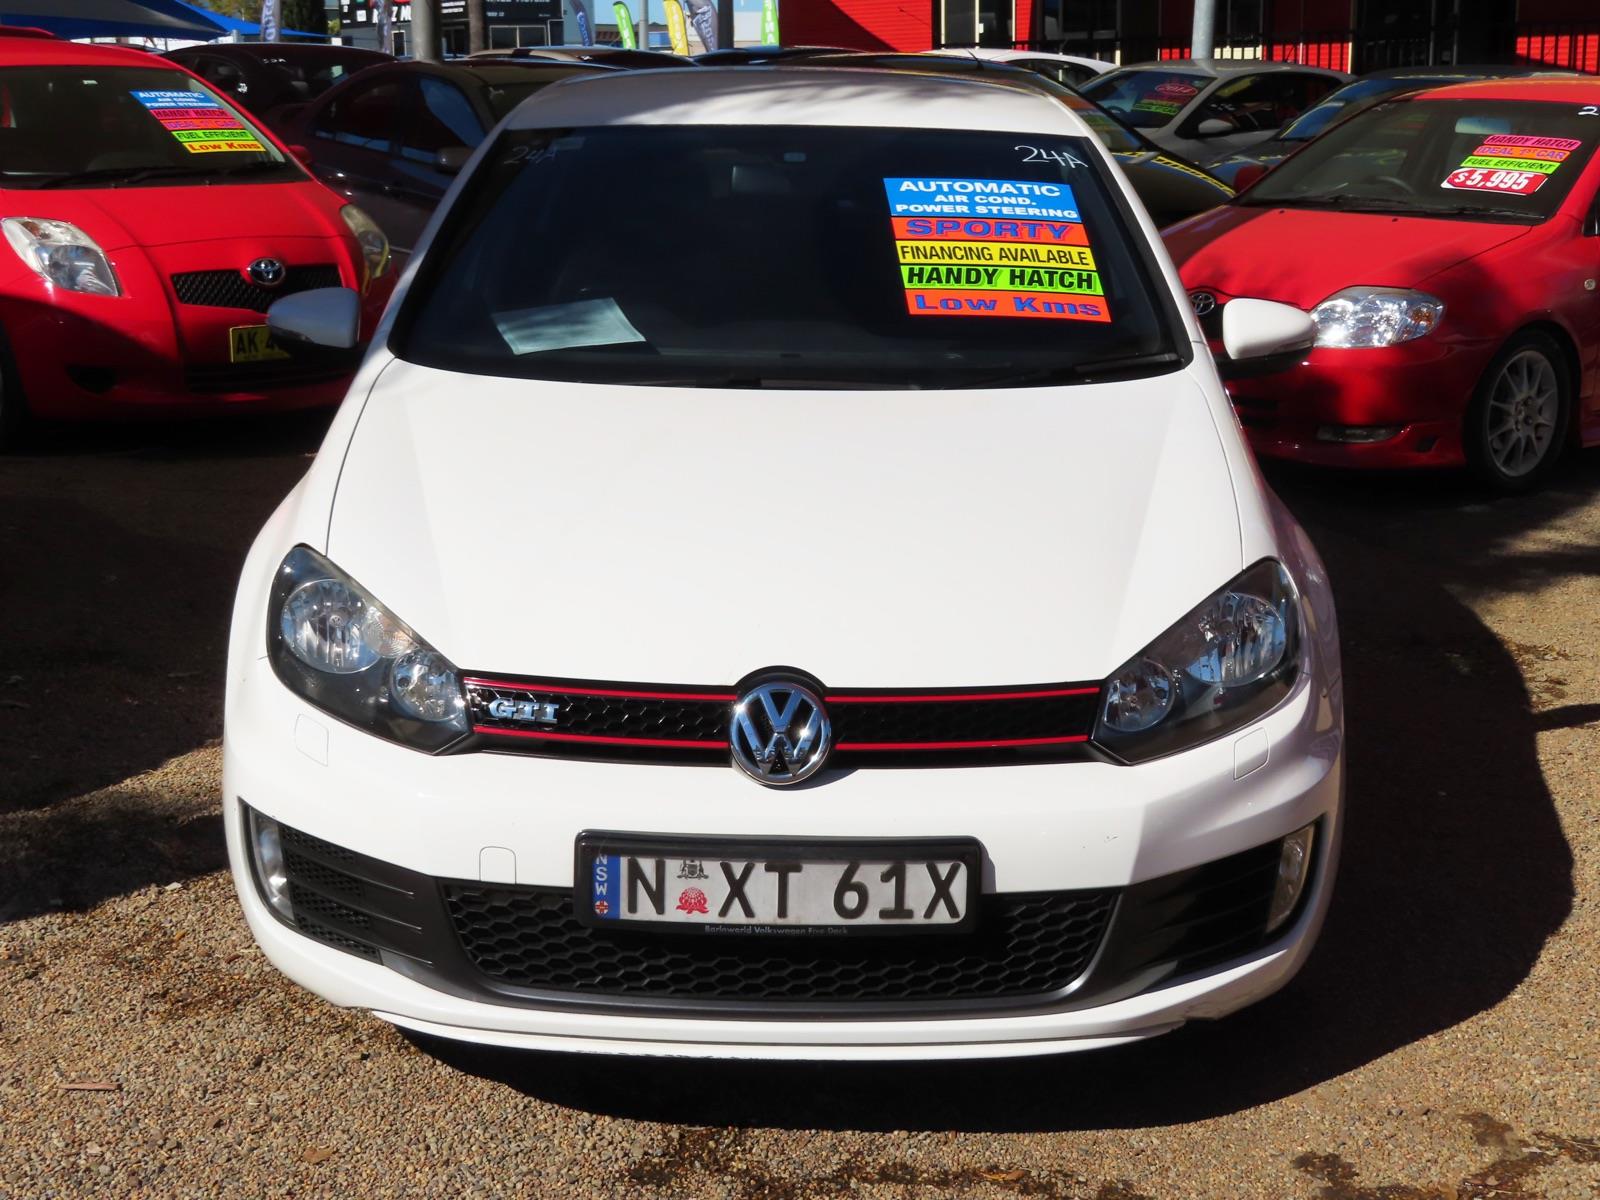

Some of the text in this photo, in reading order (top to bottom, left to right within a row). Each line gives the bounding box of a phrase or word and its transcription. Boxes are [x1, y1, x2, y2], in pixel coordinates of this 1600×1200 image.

[155, 109, 229, 118] HANDY HATCH
[177, 131, 248, 139] FUEL EFFICIENT
[1487, 135, 1577, 149] HANDY HATCH
[188, 143, 222, 151] Low
[1476, 145, 1513, 155] IDEAL
[1536, 149, 1567, 159] CAR
[1014, 145, 1089, 168] 24A
[1464, 157, 1556, 171] FUEL EFFICIENT
[1454, 169, 1534, 190] $5,995
[899, 181, 1060, 197] AUTOMATIC
[934, 195, 1037, 206] AIR COND.
[895, 204, 1078, 219] POWER STEERING
[906, 219, 1070, 240] SPORTY
[900, 245, 1090, 266] FINANCING AVAILABLE
[907, 266, 1095, 290] HANDY HATCH
[915, 294, 1102, 316] Low Kms
[489, 697, 560, 724] GTI
[595, 854, 608, 896] NSW
[754, 926, 806, 936] Volkswagen
